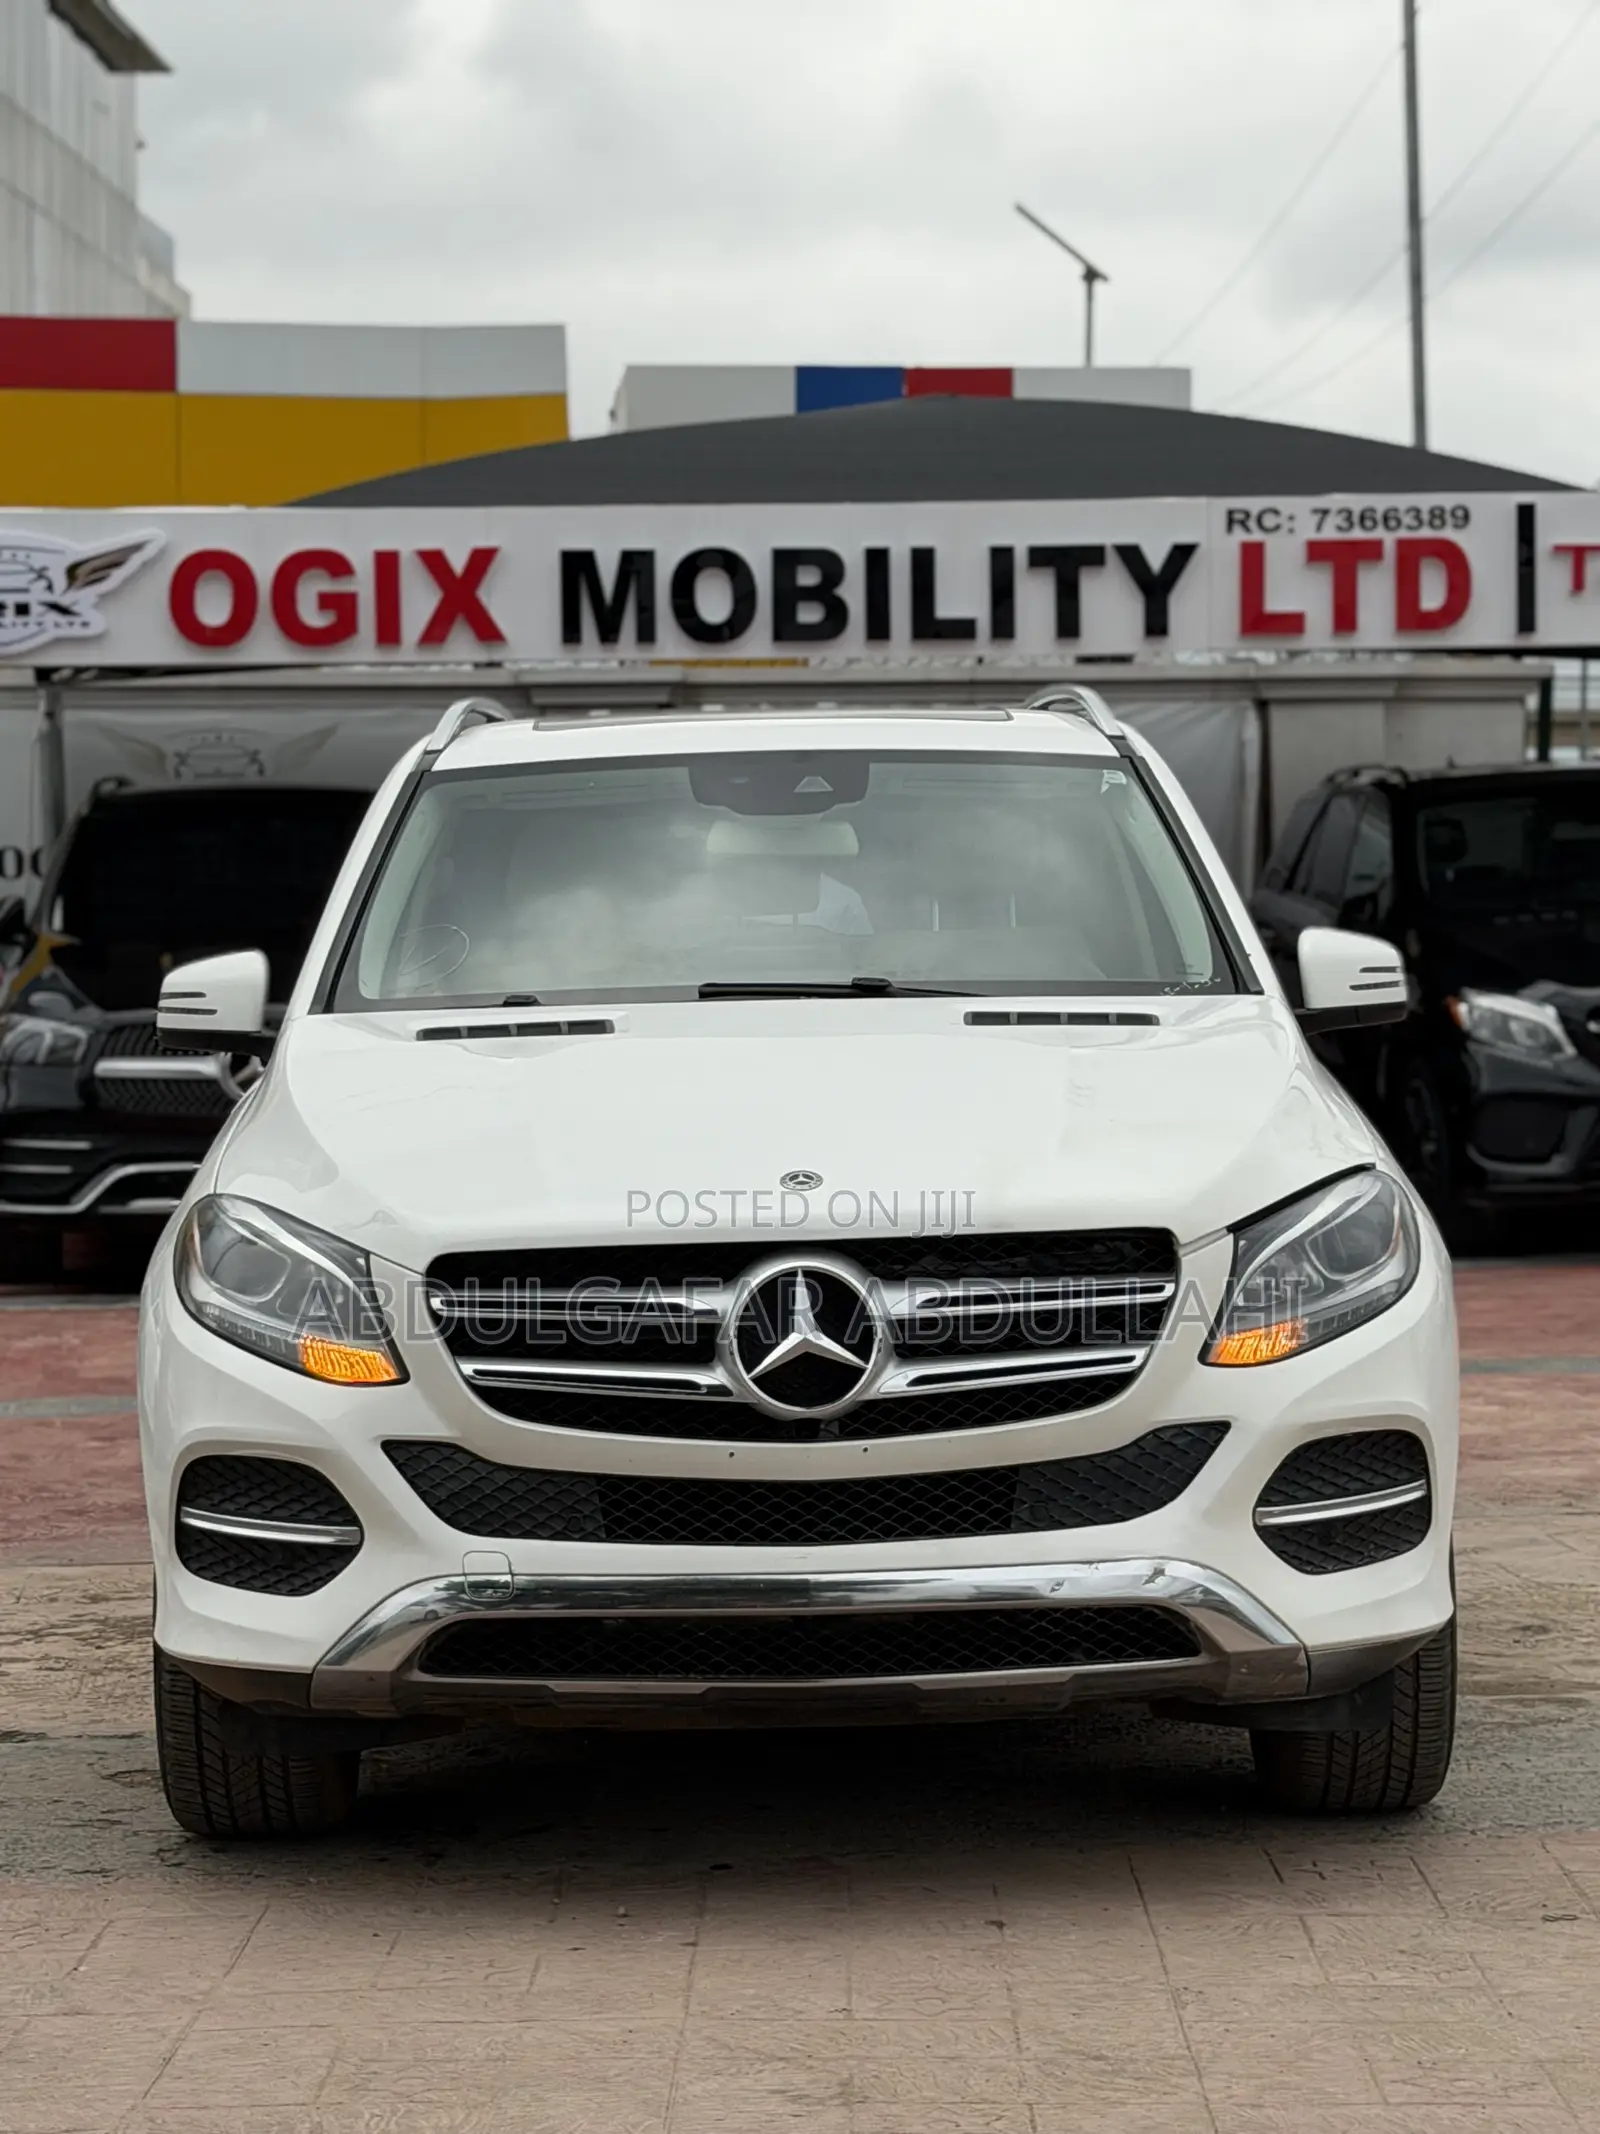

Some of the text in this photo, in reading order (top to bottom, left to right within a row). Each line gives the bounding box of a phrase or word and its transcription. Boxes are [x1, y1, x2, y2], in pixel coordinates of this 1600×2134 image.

[1226, 505, 1471, 534] RC: 7366389
[169, 537, 1472, 648] OGIX MOBILITY LTD
